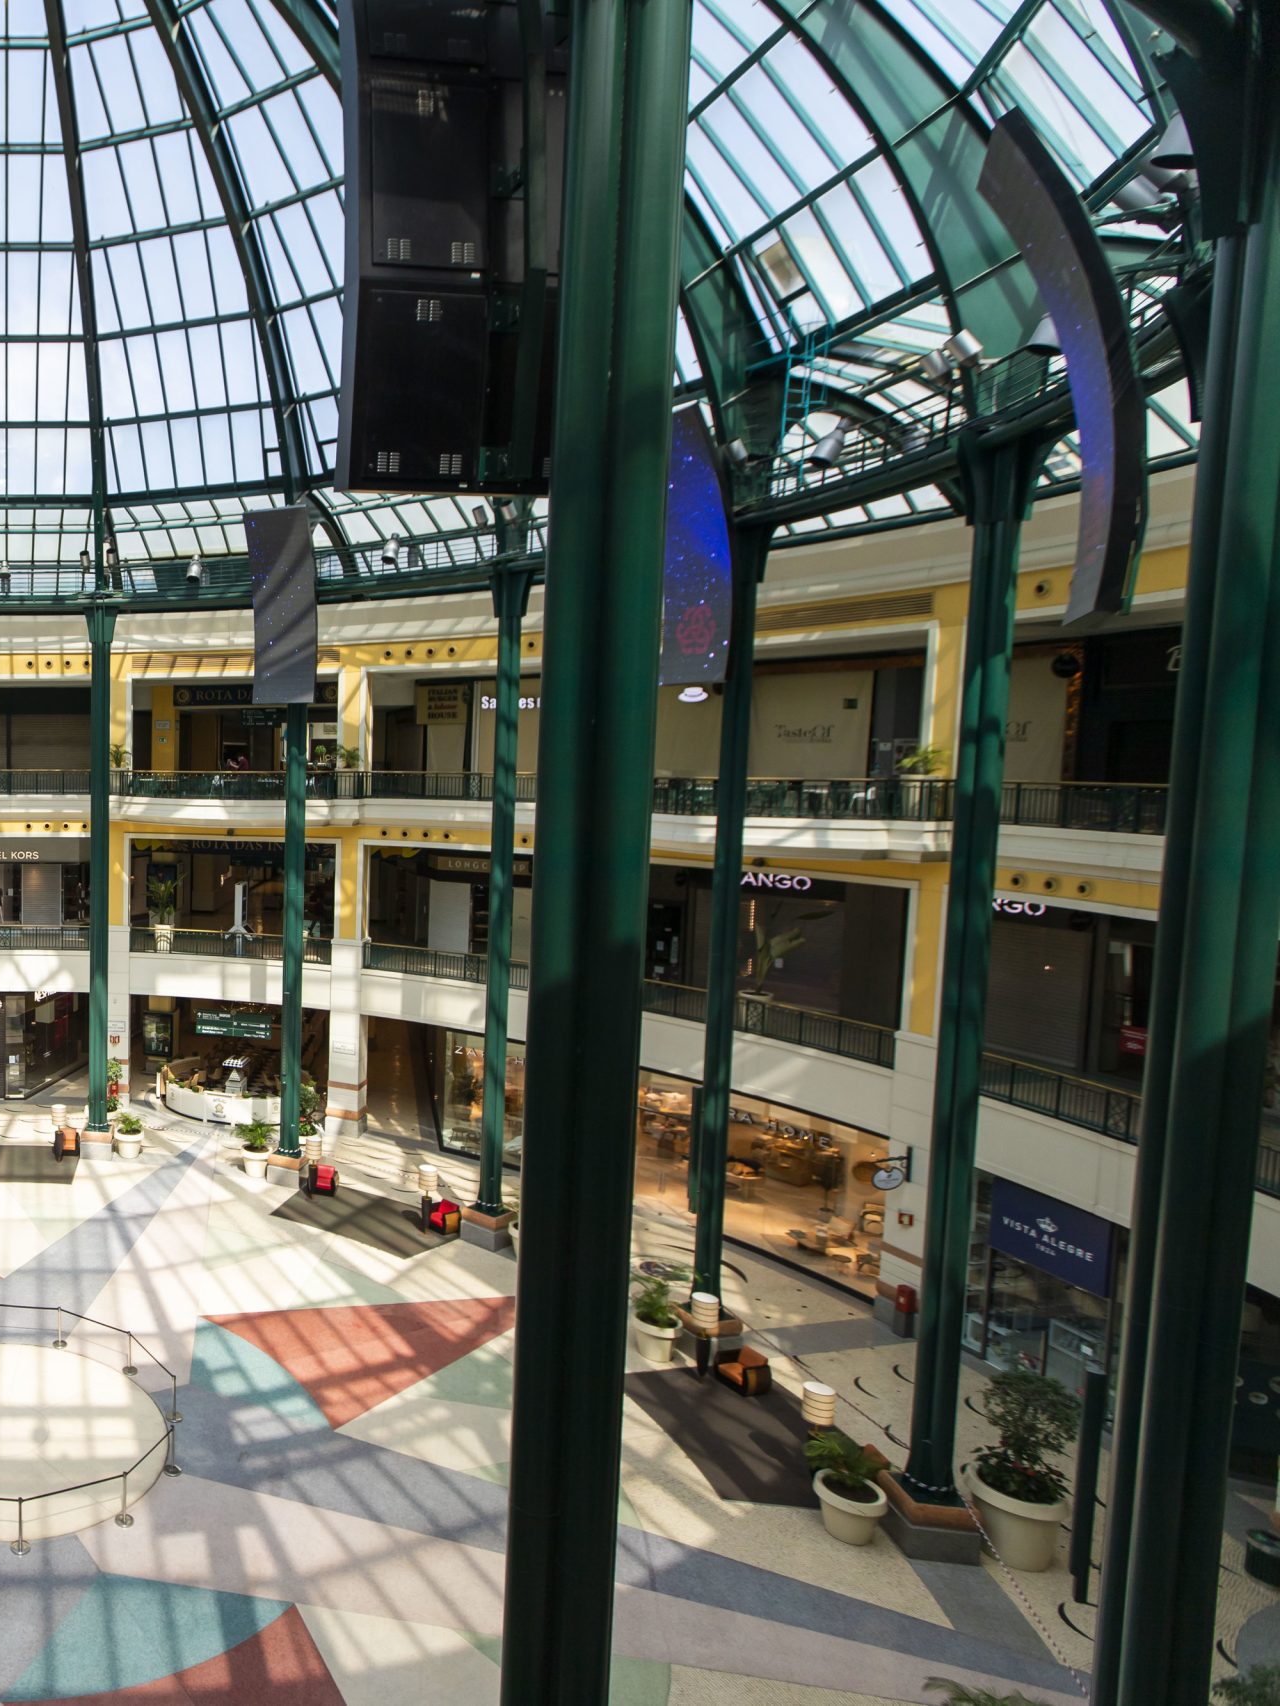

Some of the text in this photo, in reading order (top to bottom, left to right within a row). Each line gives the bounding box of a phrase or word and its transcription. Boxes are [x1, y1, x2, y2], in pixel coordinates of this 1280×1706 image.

[196, 688, 232, 701] ROTA
[10, 851, 39, 860] KORS
[448, 860, 526, 872] LONGCP
[740, 871, 812, 891] ANGO
[766, 1118, 831, 1150] HOME
[1002, 1216, 1096, 1263] VISTA ALEGRE
